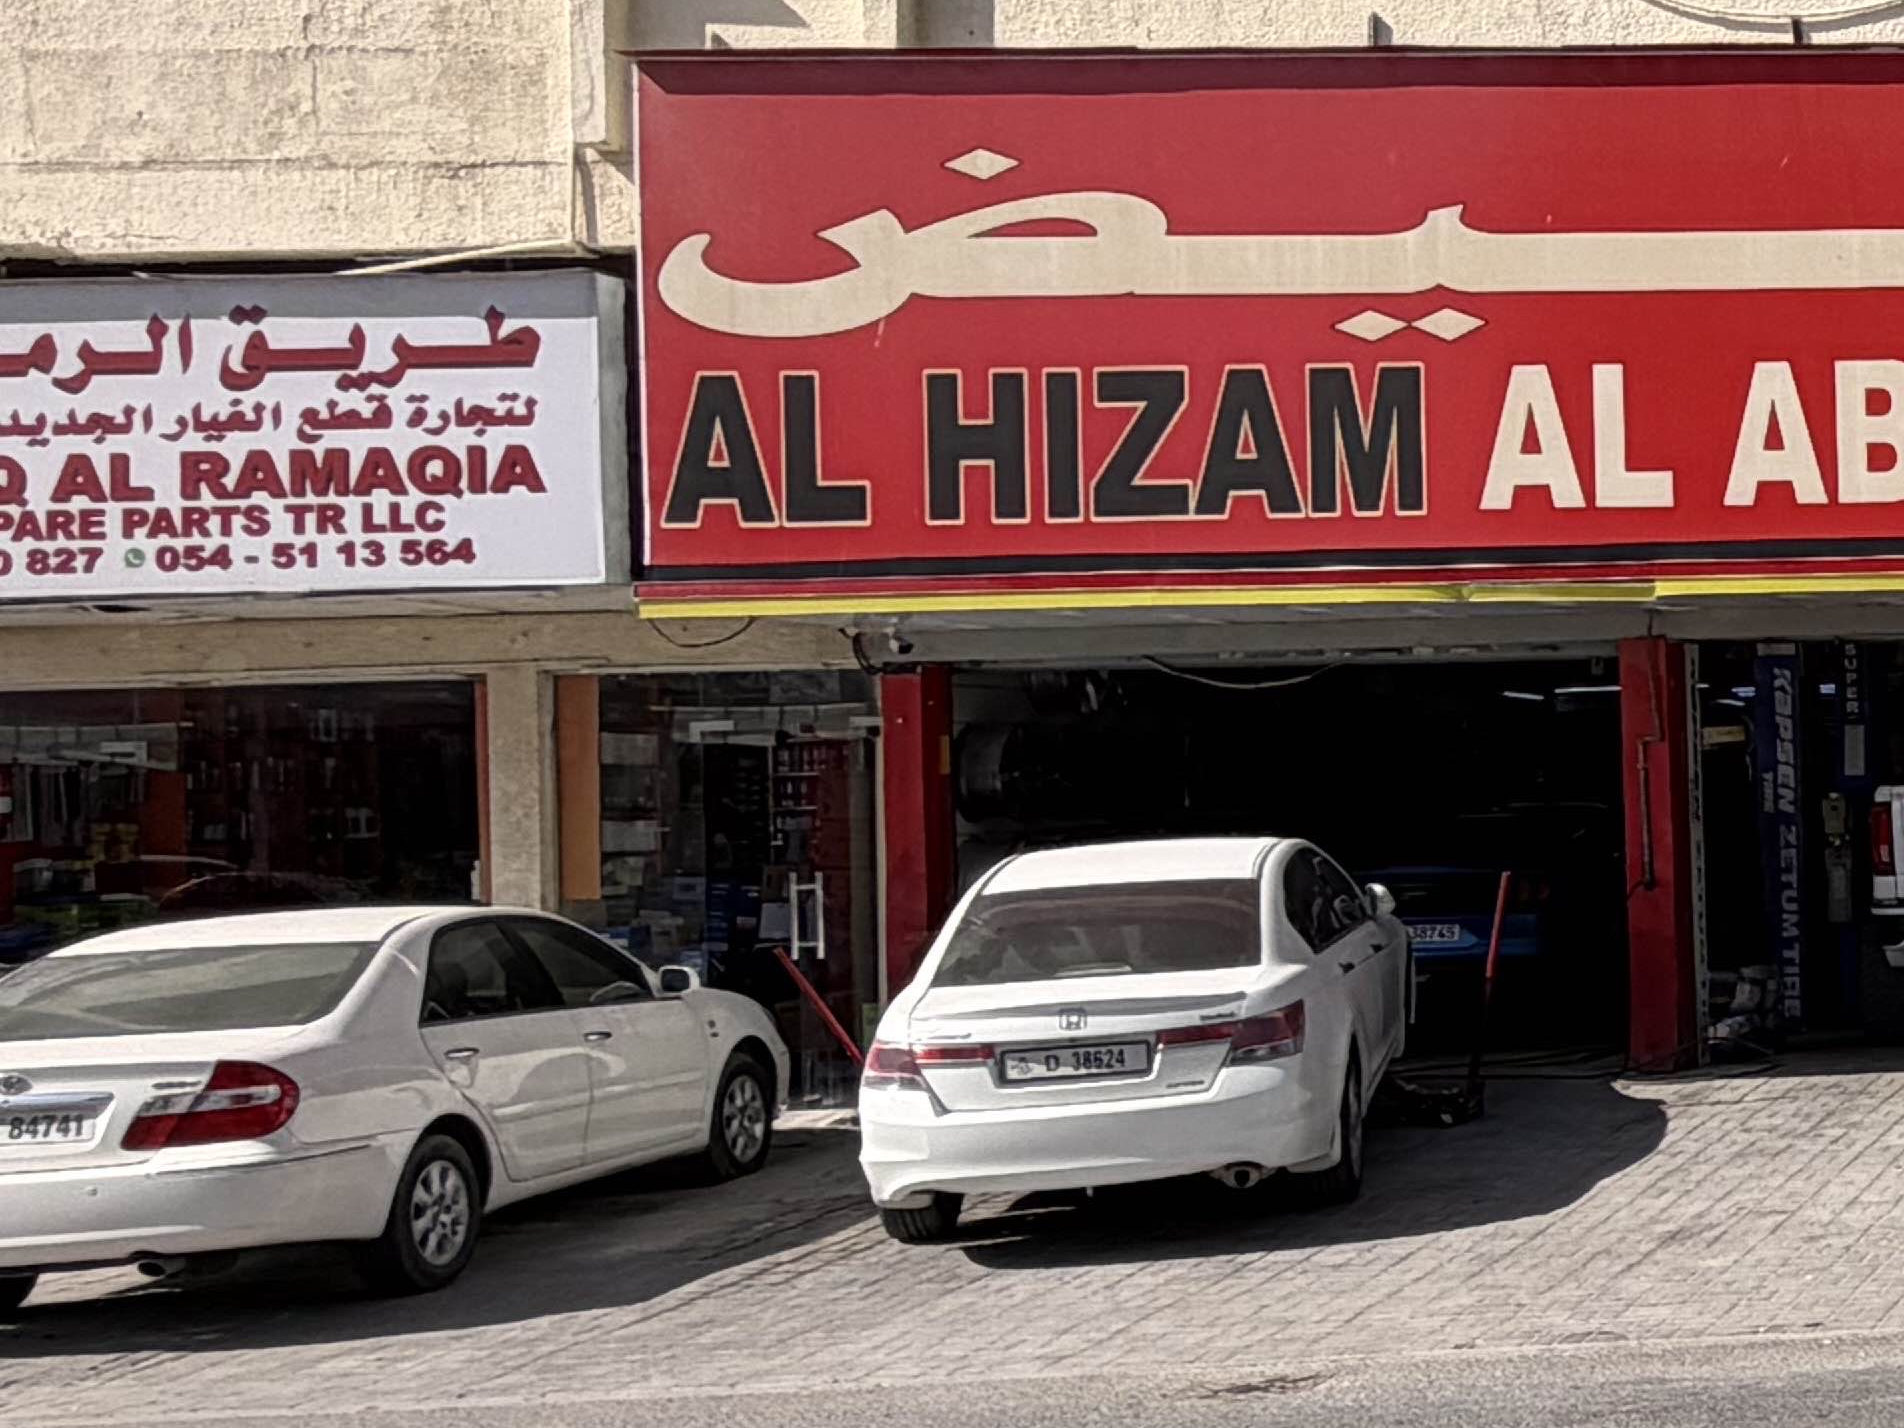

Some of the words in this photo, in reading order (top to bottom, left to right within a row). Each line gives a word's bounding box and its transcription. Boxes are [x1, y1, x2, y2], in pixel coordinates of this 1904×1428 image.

[220, 304, 542, 391] طريق
[298, 393, 393, 442] قطع
[406, 392, 538, 437] لتجارة
[661, 369, 872, 529] AL
[921, 362, 1427, 526] HIZAM
[1479, 363, 1675, 510] AL
[50, 453, 155, 503] AL
[180, 444, 548, 501] RAMAQIA
[122, 504, 271, 539] PARTS
[284, 504, 346, 536] TR
[361, 501, 447, 533] LLC
[26, 547, 103, 575] 827
[156, 544, 233, 572] 054
[272, 543, 318, 568] 51
[336, 542, 386, 567] 13
[400, 539, 476, 565] 564
[8, 1114, 85, 1140] 84741
